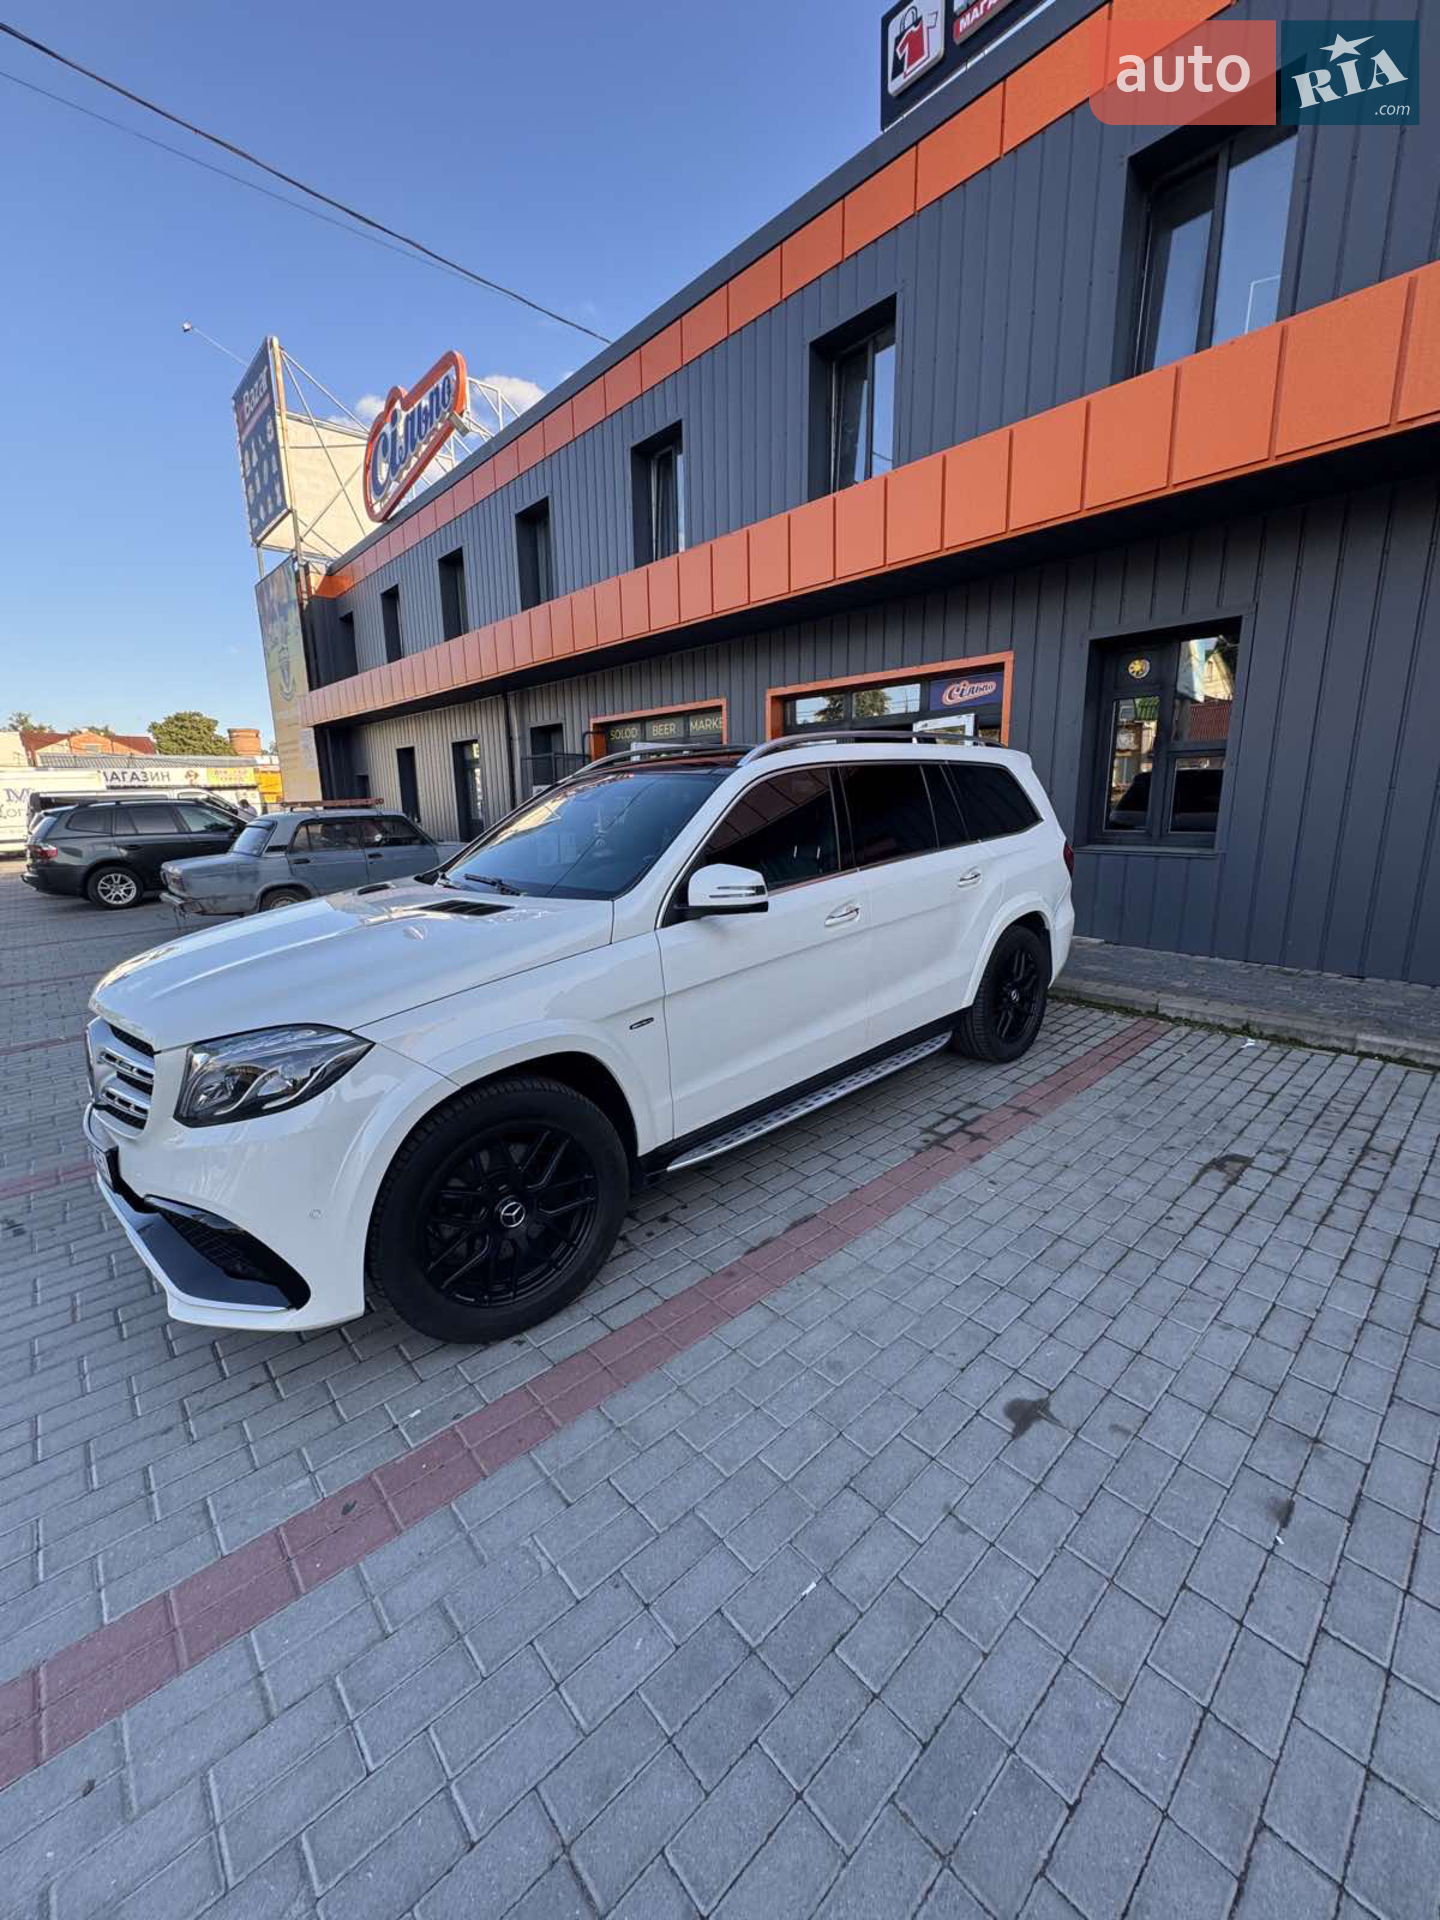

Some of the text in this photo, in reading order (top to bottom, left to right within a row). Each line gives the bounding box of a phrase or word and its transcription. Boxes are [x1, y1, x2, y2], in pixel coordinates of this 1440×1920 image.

[372, 374, 452, 497] Сільпо
[610, 727, 638, 740] SOLOD
[652, 722, 677, 736] BEER
